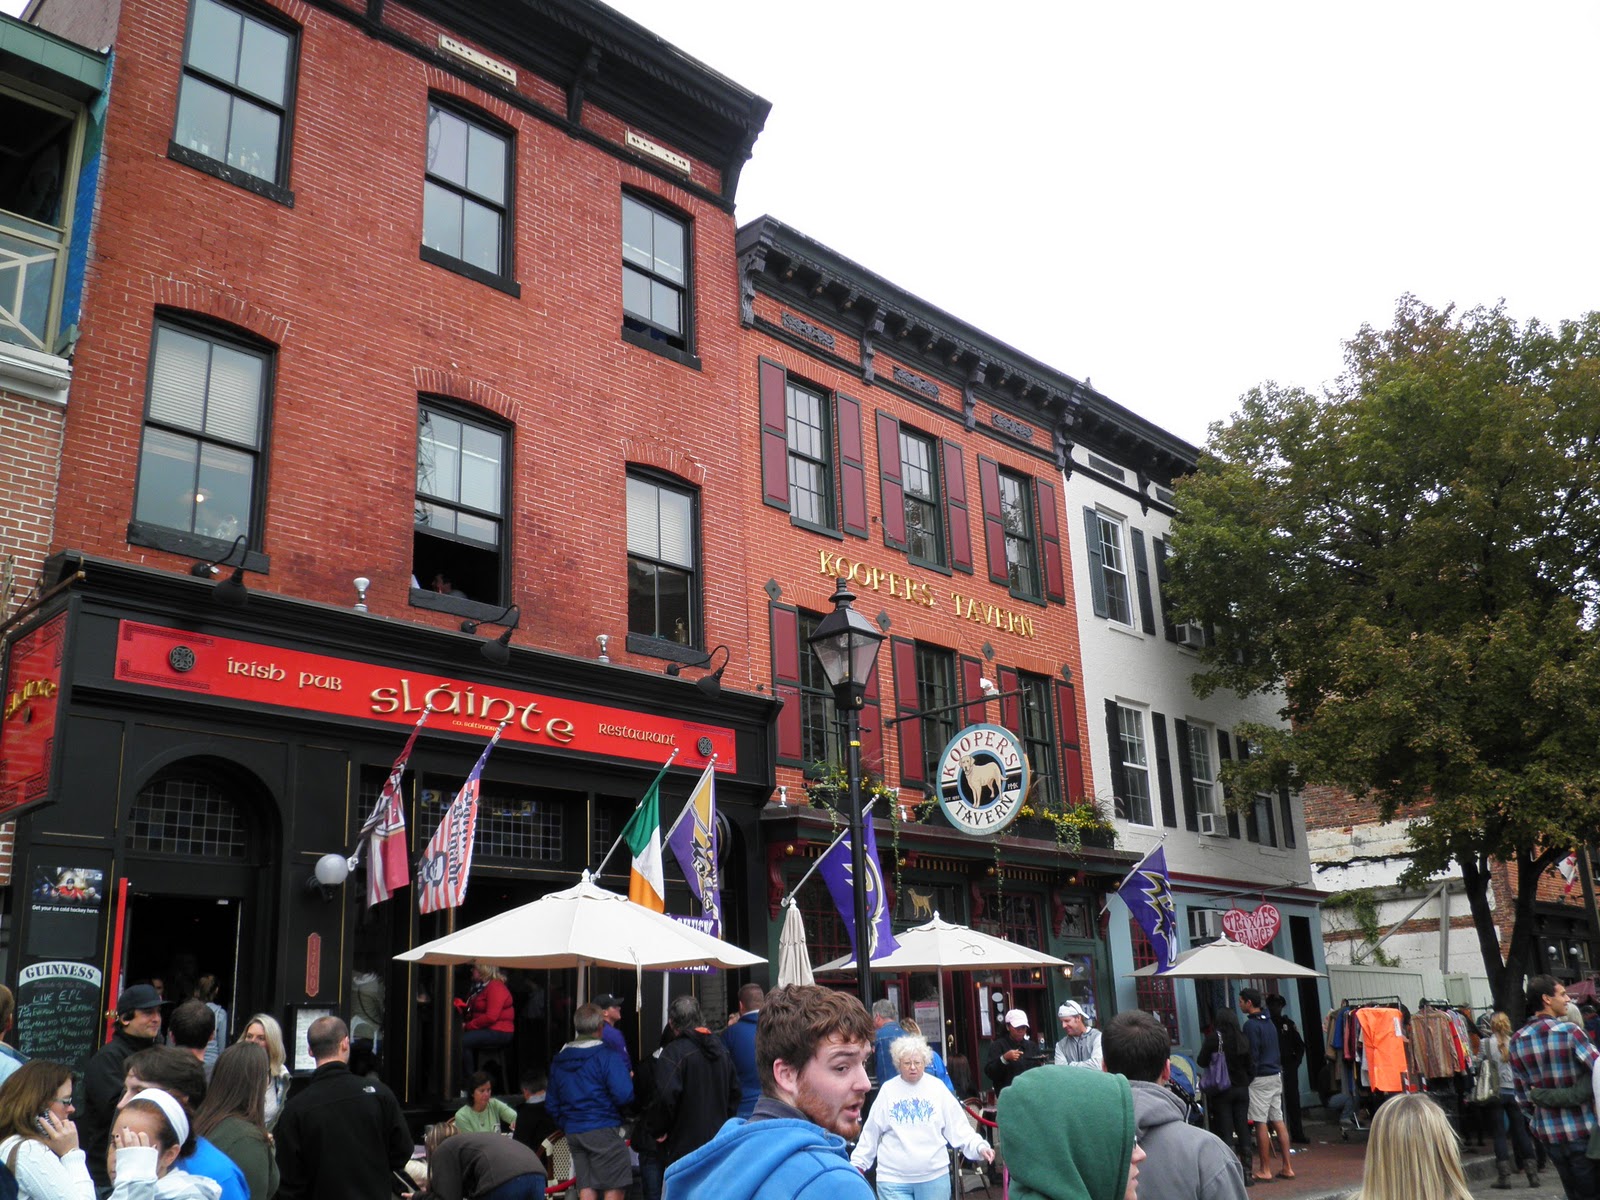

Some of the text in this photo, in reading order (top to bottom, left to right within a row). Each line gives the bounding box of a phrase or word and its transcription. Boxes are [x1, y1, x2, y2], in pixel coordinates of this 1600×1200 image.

[817, 549, 1034, 639] KOOPERS TAVERN
[943, 731, 1018, 778] KOOPER'S
[955, 794, 1015, 826] TAVERN
[25, 964, 95, 980] GUINNESS
